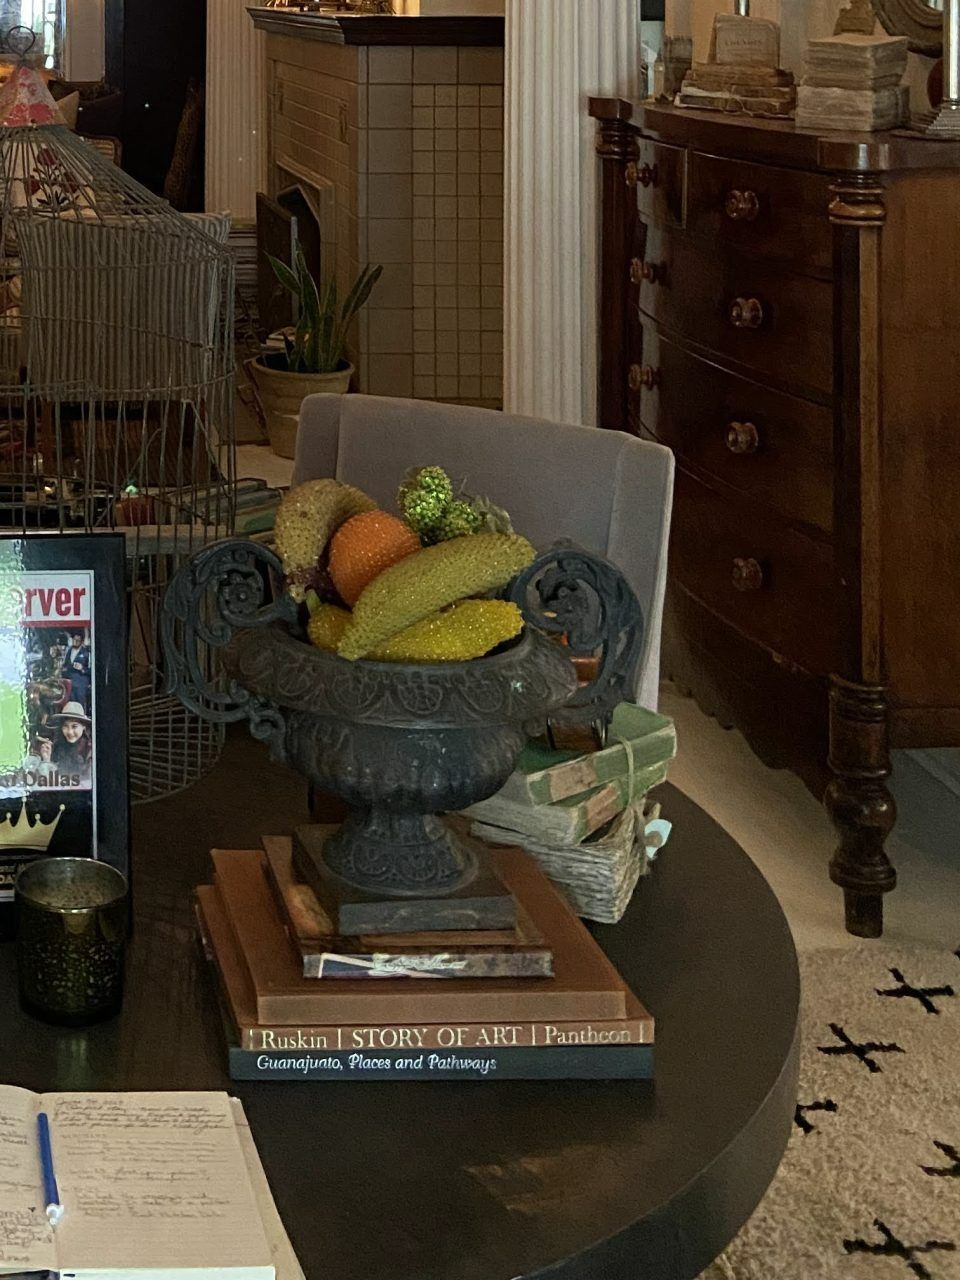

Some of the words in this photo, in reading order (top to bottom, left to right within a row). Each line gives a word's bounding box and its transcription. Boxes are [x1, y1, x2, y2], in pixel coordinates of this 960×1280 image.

[23, 770, 81, 788] Dallas
[261, 1029, 327, 1049] Ruskin
[352, 1028, 428, 1048] STORY
[437, 1027, 469, 1047] OF
[475, 1025, 522, 1046] ART
[544, 1025, 632, 1045] Pantheon
[256, 1054, 343, 1074] Guanajuato,
[348, 1053, 391, 1070] Places
[395, 1054, 423, 1070] and
[427, 1053, 497, 1074] Pathways
